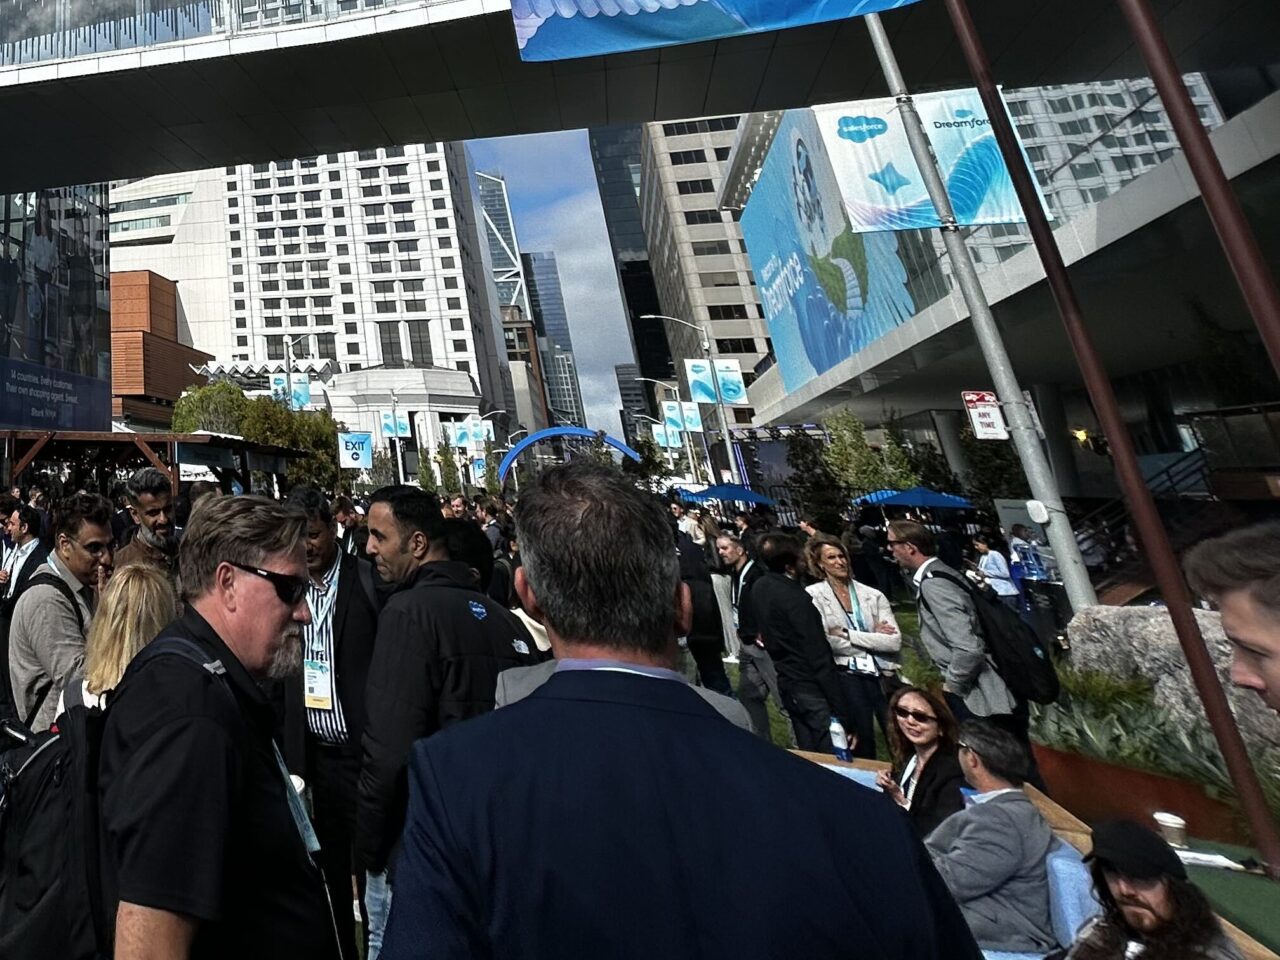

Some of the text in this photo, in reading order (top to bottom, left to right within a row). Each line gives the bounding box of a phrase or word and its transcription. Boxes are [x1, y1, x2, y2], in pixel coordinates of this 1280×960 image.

[842, 122, 884, 133] salesforce
[933, 117, 991, 130] Dreamforc
[979, 421, 996, 429] TIME
[344, 441, 366, 451] EXIT
